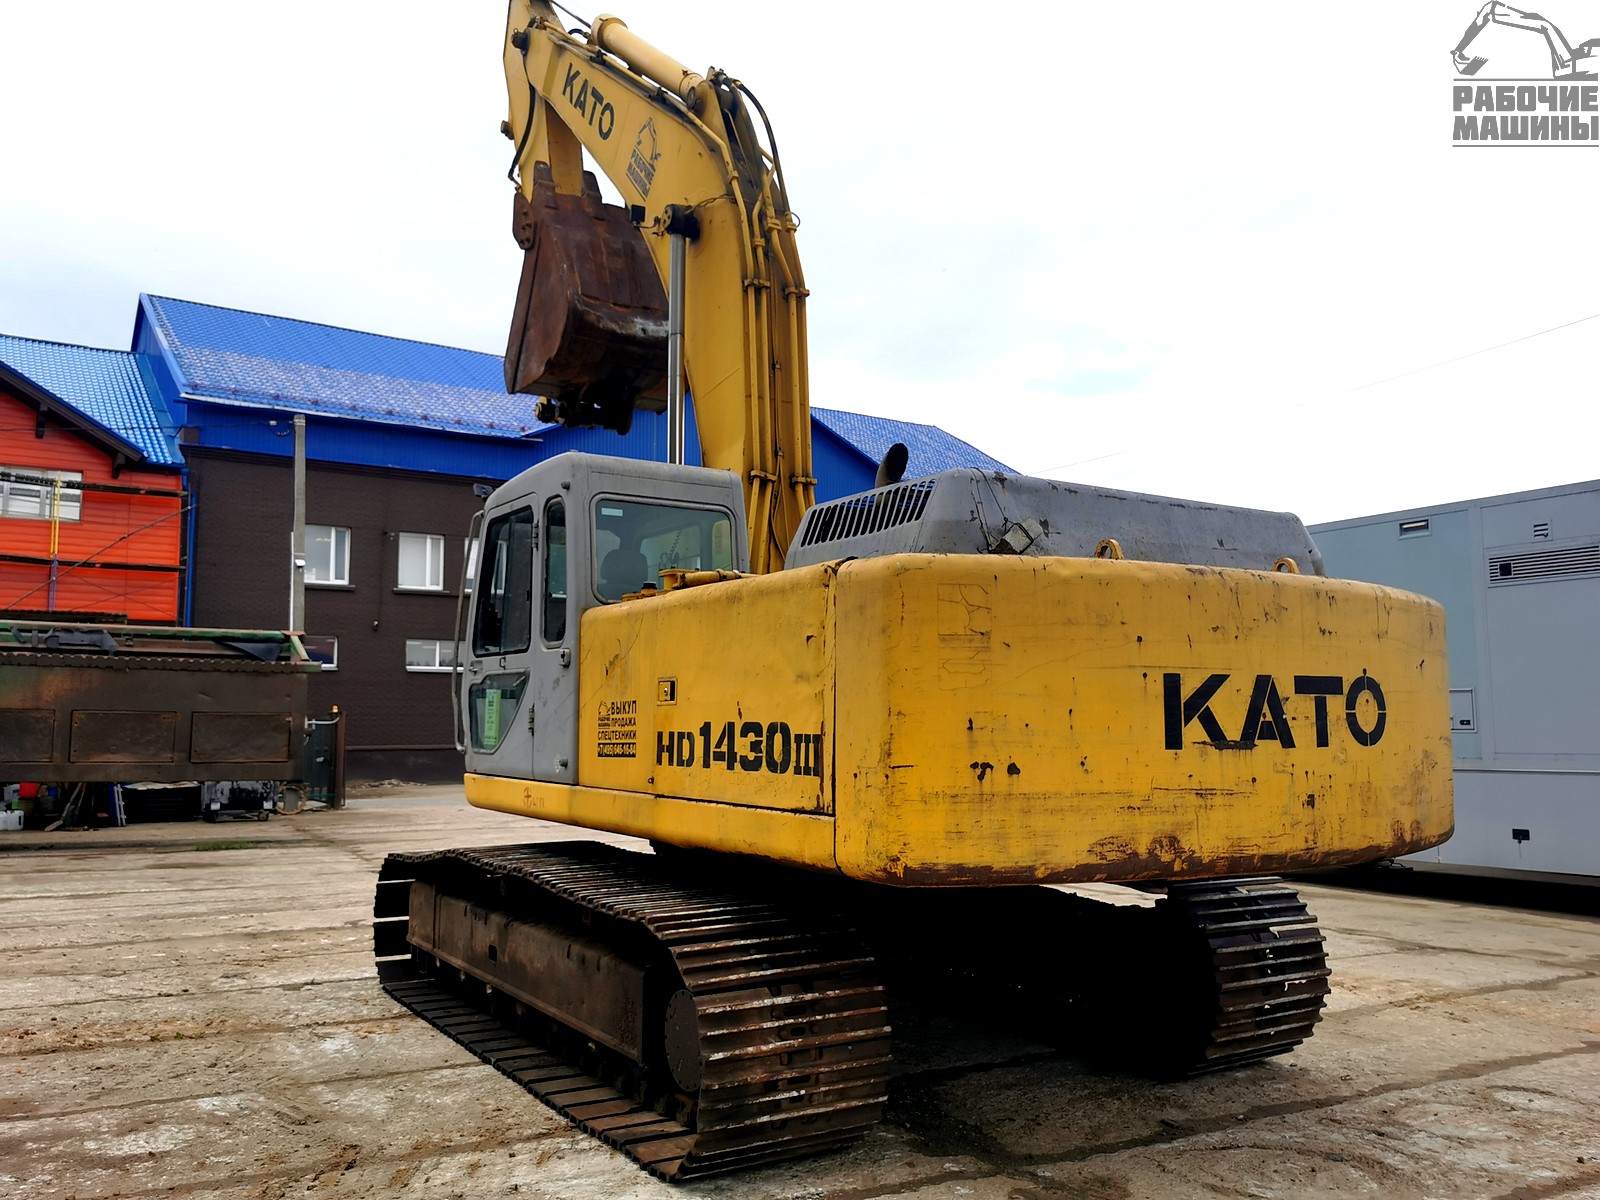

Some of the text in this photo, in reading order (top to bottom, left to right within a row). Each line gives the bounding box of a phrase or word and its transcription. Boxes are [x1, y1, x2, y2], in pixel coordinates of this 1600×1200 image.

[562, 63, 614, 140] KATO
[611, 700, 637, 715] ВЫКУП
[1163, 672, 1387, 750] KATO
[611, 717, 636, 728] ПРОДАЖА
[598, 730, 637, 741] СПЕЦТЕХНИКИ
